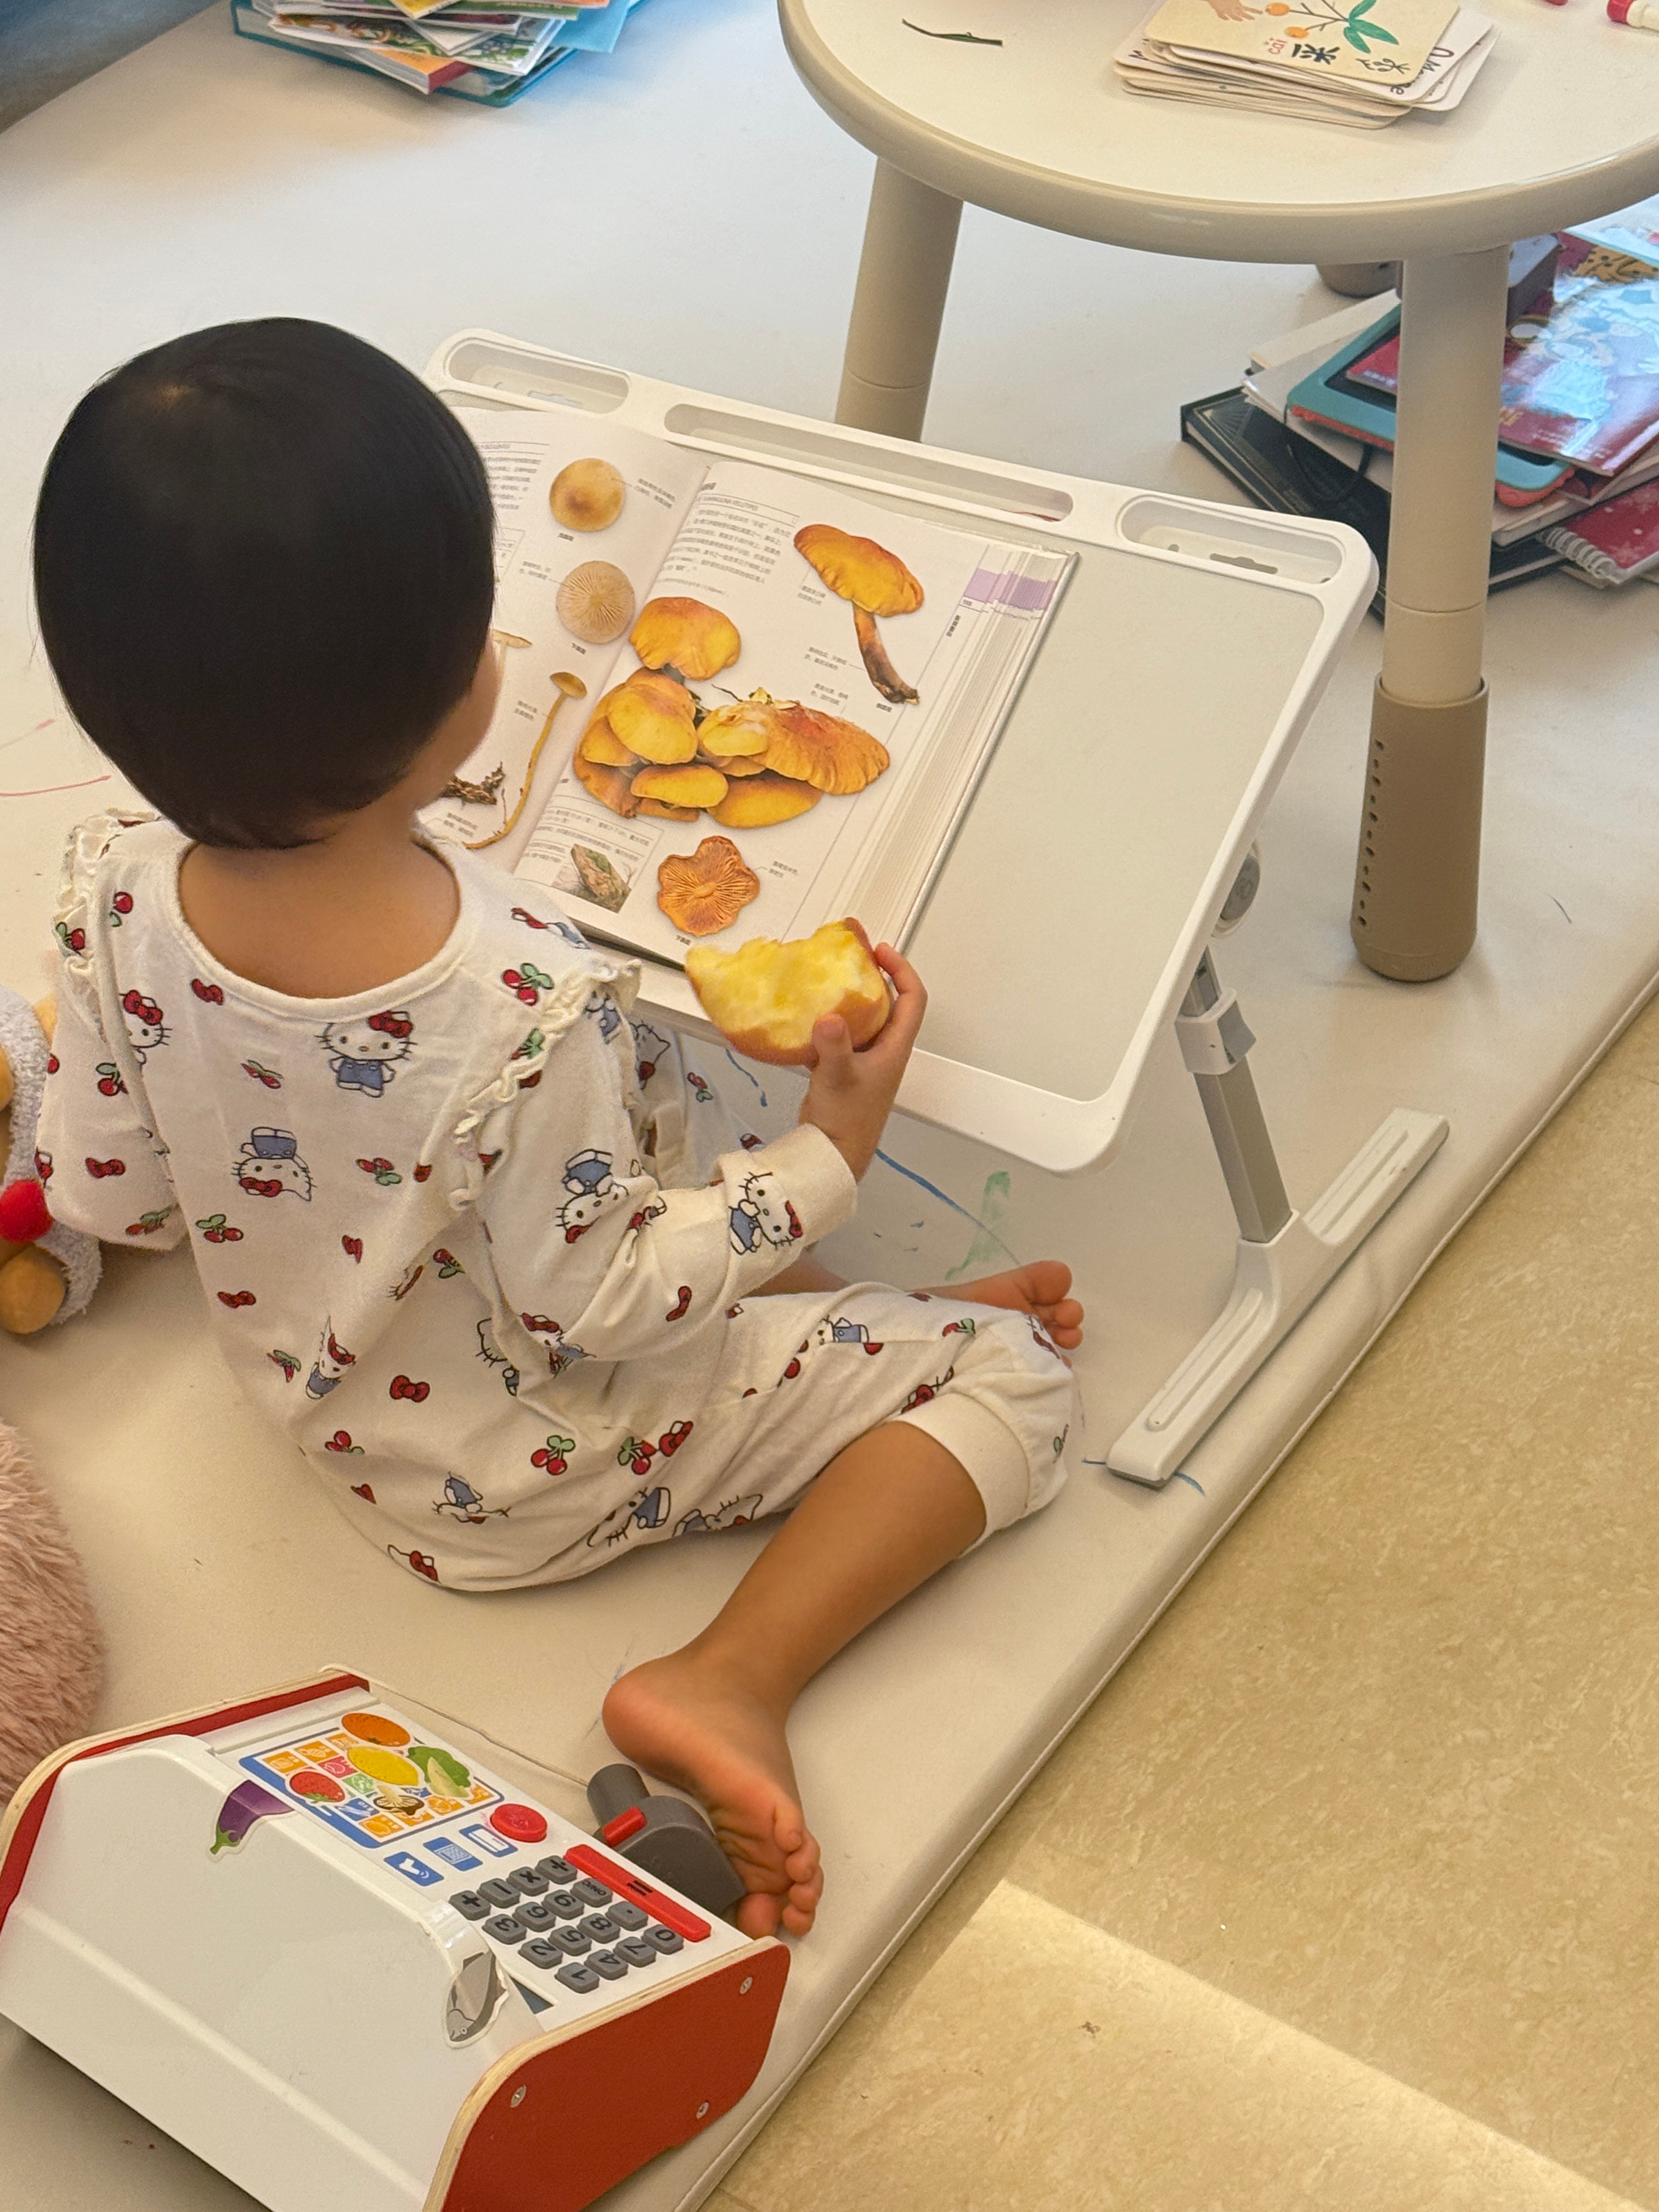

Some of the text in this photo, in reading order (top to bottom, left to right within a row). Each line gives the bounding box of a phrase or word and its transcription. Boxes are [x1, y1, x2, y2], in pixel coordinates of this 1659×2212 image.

[554, 1894, 576, 1907] 9
[526, 1906, 549, 1918] 6
[494, 1918, 519, 1932] 3
[590, 1917, 612, 1930] 8
[561, 1930, 585, 1943] 5
[654, 1929, 675, 1942] 0
[531, 1940, 557, 1956] 2
[625, 1944, 646, 1955] 7
[599, 1954, 621, 1965] 4
[571, 1969, 588, 1980] 1
